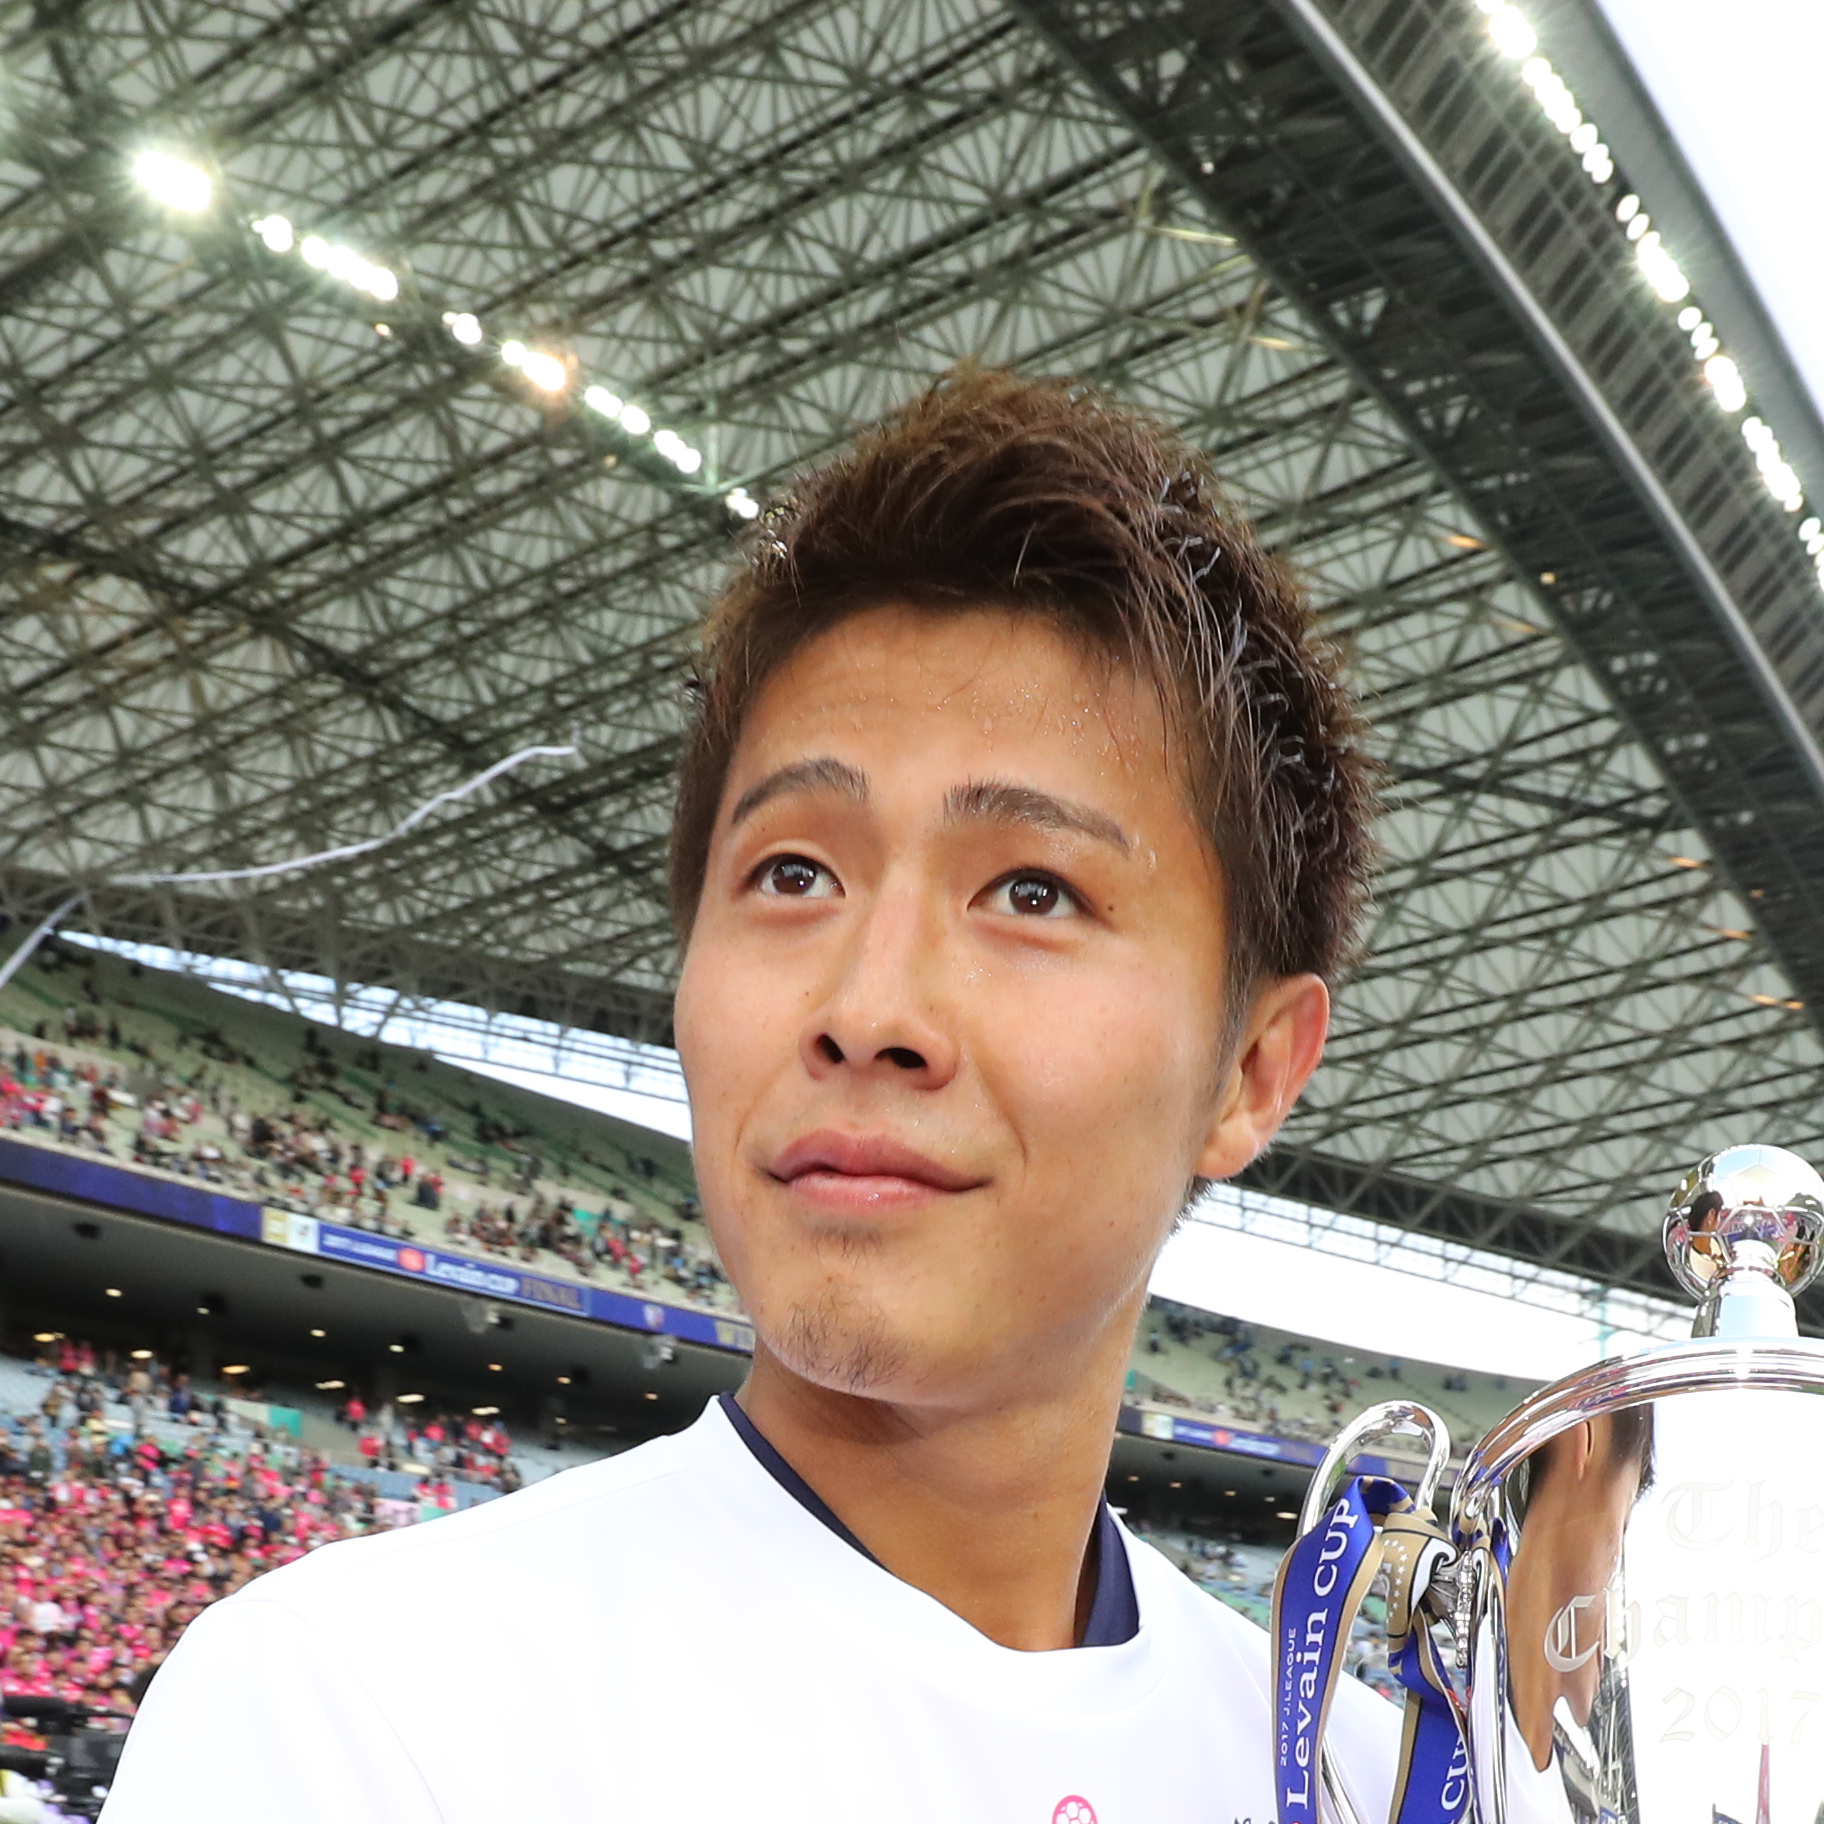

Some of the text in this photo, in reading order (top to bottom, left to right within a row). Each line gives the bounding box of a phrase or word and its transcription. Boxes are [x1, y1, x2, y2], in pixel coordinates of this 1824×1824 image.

[1279, 1628, 1297, 1767] 2017 J.LEAGUE
[1286, 1608, 1328, 1810] Levain
[1313, 1499, 1361, 1598] CUP
[1659, 1685, 1822, 1744] 2017
